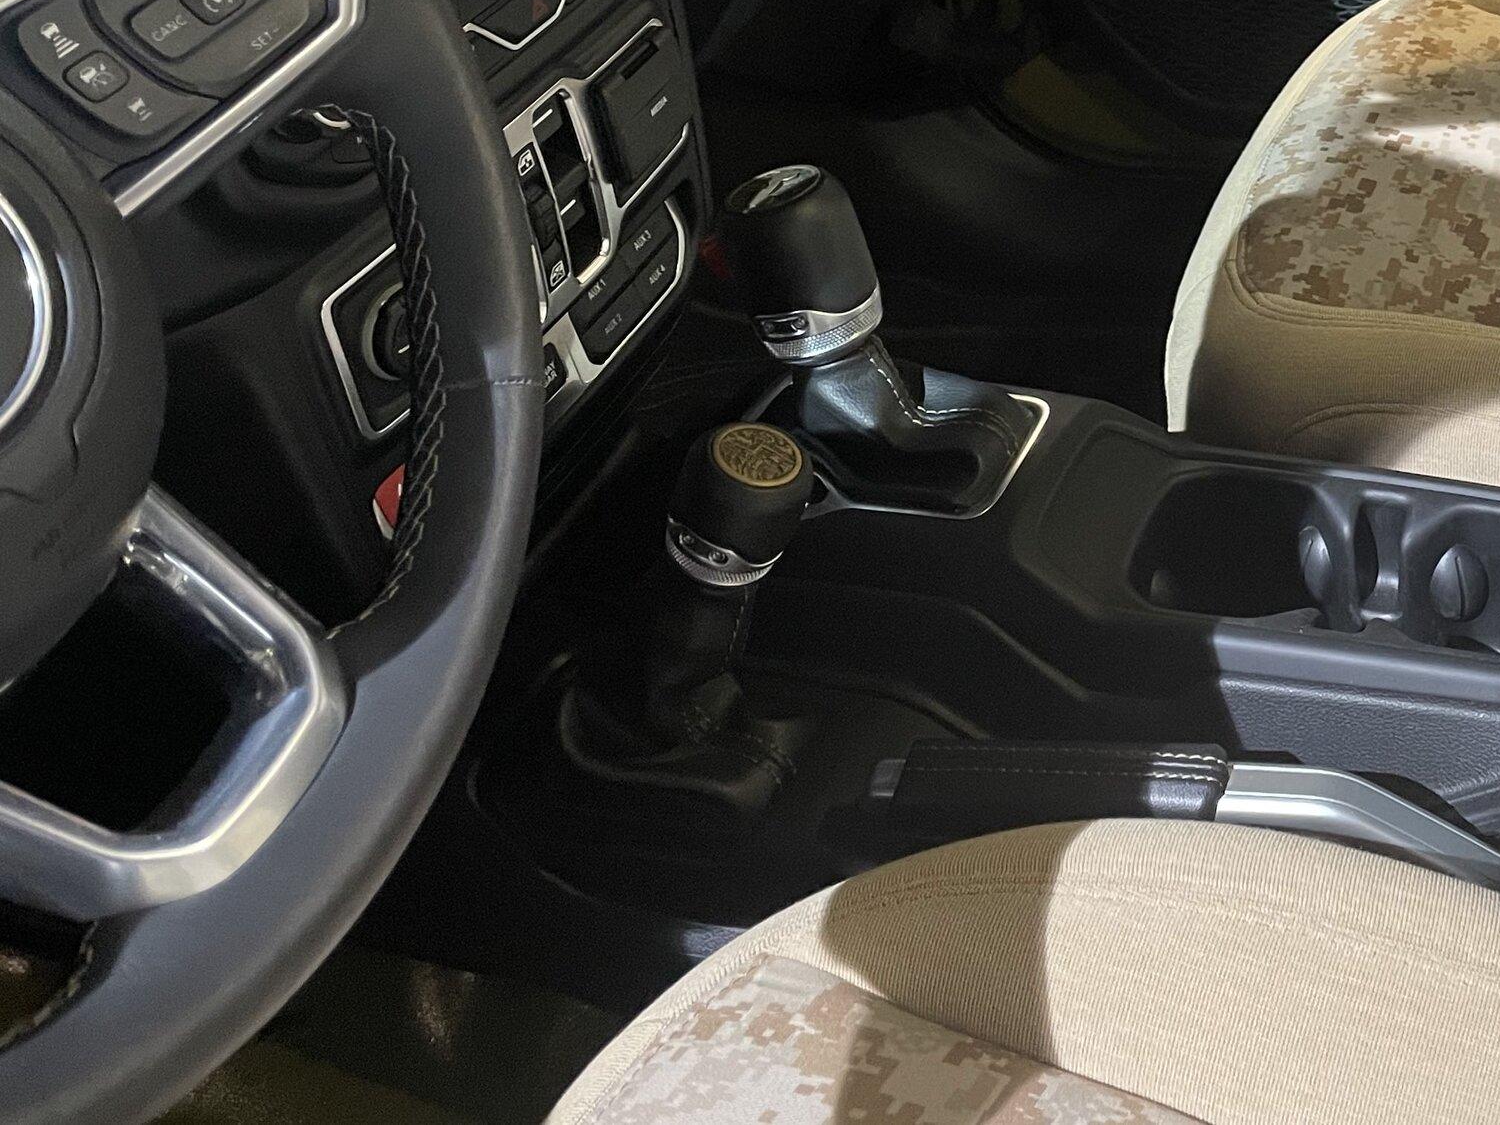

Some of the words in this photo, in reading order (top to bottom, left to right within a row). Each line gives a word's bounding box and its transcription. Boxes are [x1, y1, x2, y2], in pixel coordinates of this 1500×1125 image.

[152, 15, 187, 42] CANC
[633, 233, 647, 251] AUX
[649, 269, 661, 285] AUX
[587, 283, 601, 301] AUX
